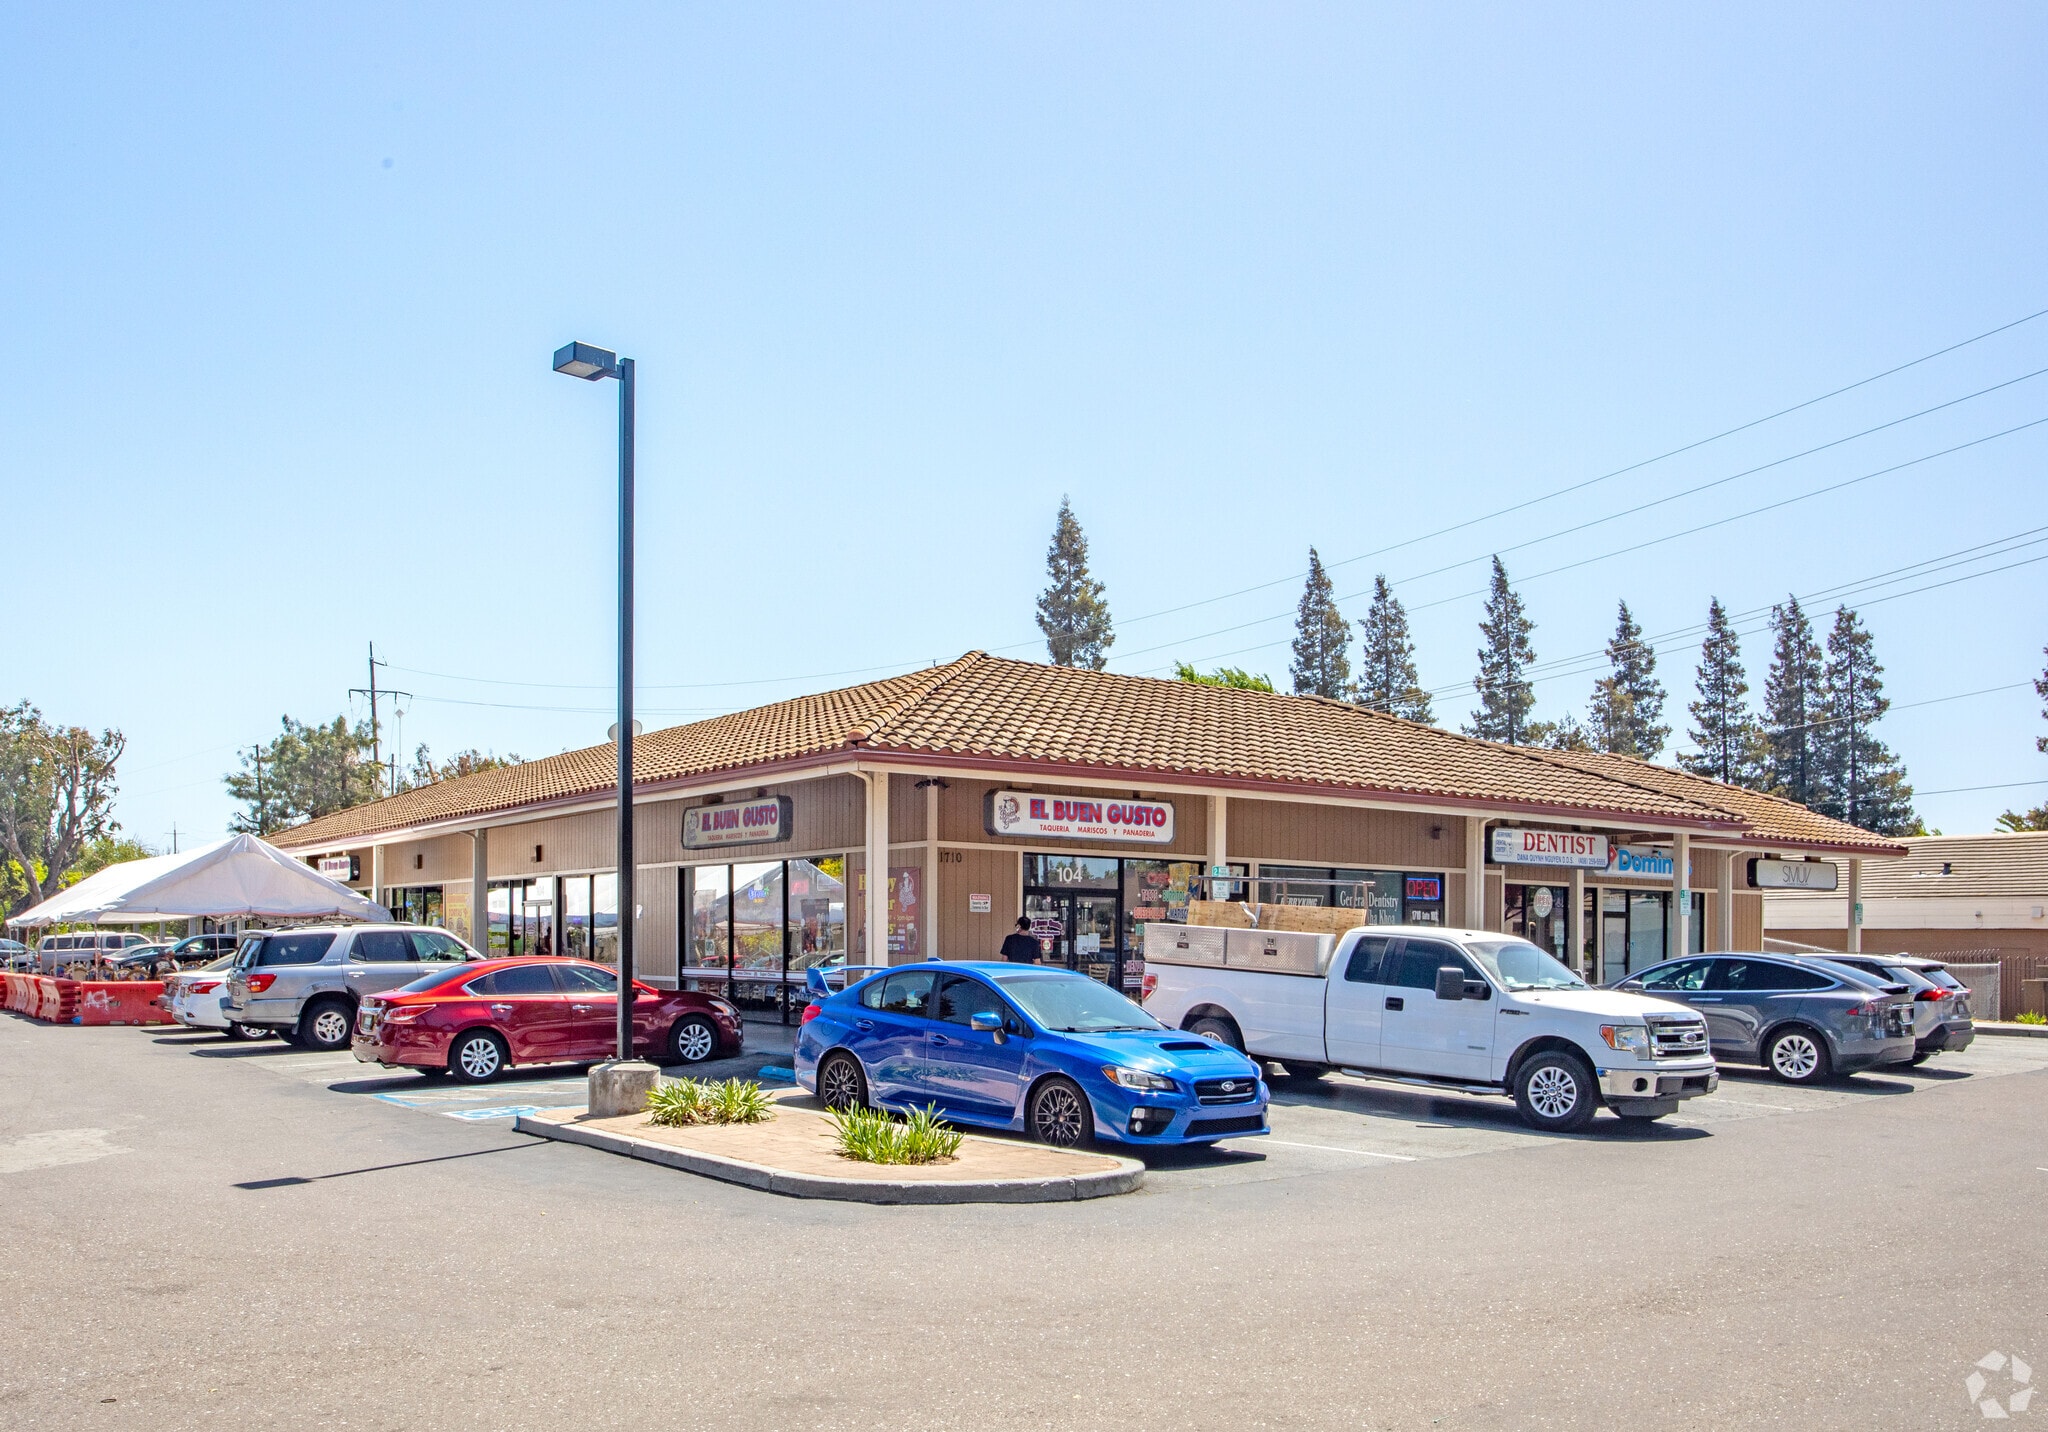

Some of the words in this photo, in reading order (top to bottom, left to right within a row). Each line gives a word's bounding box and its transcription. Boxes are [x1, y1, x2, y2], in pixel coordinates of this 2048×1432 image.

[701, 812, 711, 832] EL
[713, 808, 740, 831] BUEN
[743, 804, 778, 828] GUSTO
[1030, 798, 1049, 820] EL
[1053, 800, 1103, 823] BUEN
[1107, 803, 1167, 827] GUSTO
[1040, 824, 1070, 833] TAQUERIA
[1077, 826, 1108, 835] MARISCOS
[1123, 828, 1156, 838] PANADERIA
[1523, 832, 1596, 855] DENTIST
[940, 852, 962, 863] 1710
[1618, 848, 1693, 877] Domin
[1057, 867, 1083, 883] 104
[1213, 867, 1219, 876] 2
[1141, 889, 1158, 902] TACOS
[1407, 880, 1439, 897] OPEN
[1281, 897, 1318, 907] BRRYKING
[1340, 890, 1366, 907] Genera
[1368, 892, 1399, 912] Dentistry
[1170, 908, 1188, 919] MARISC
